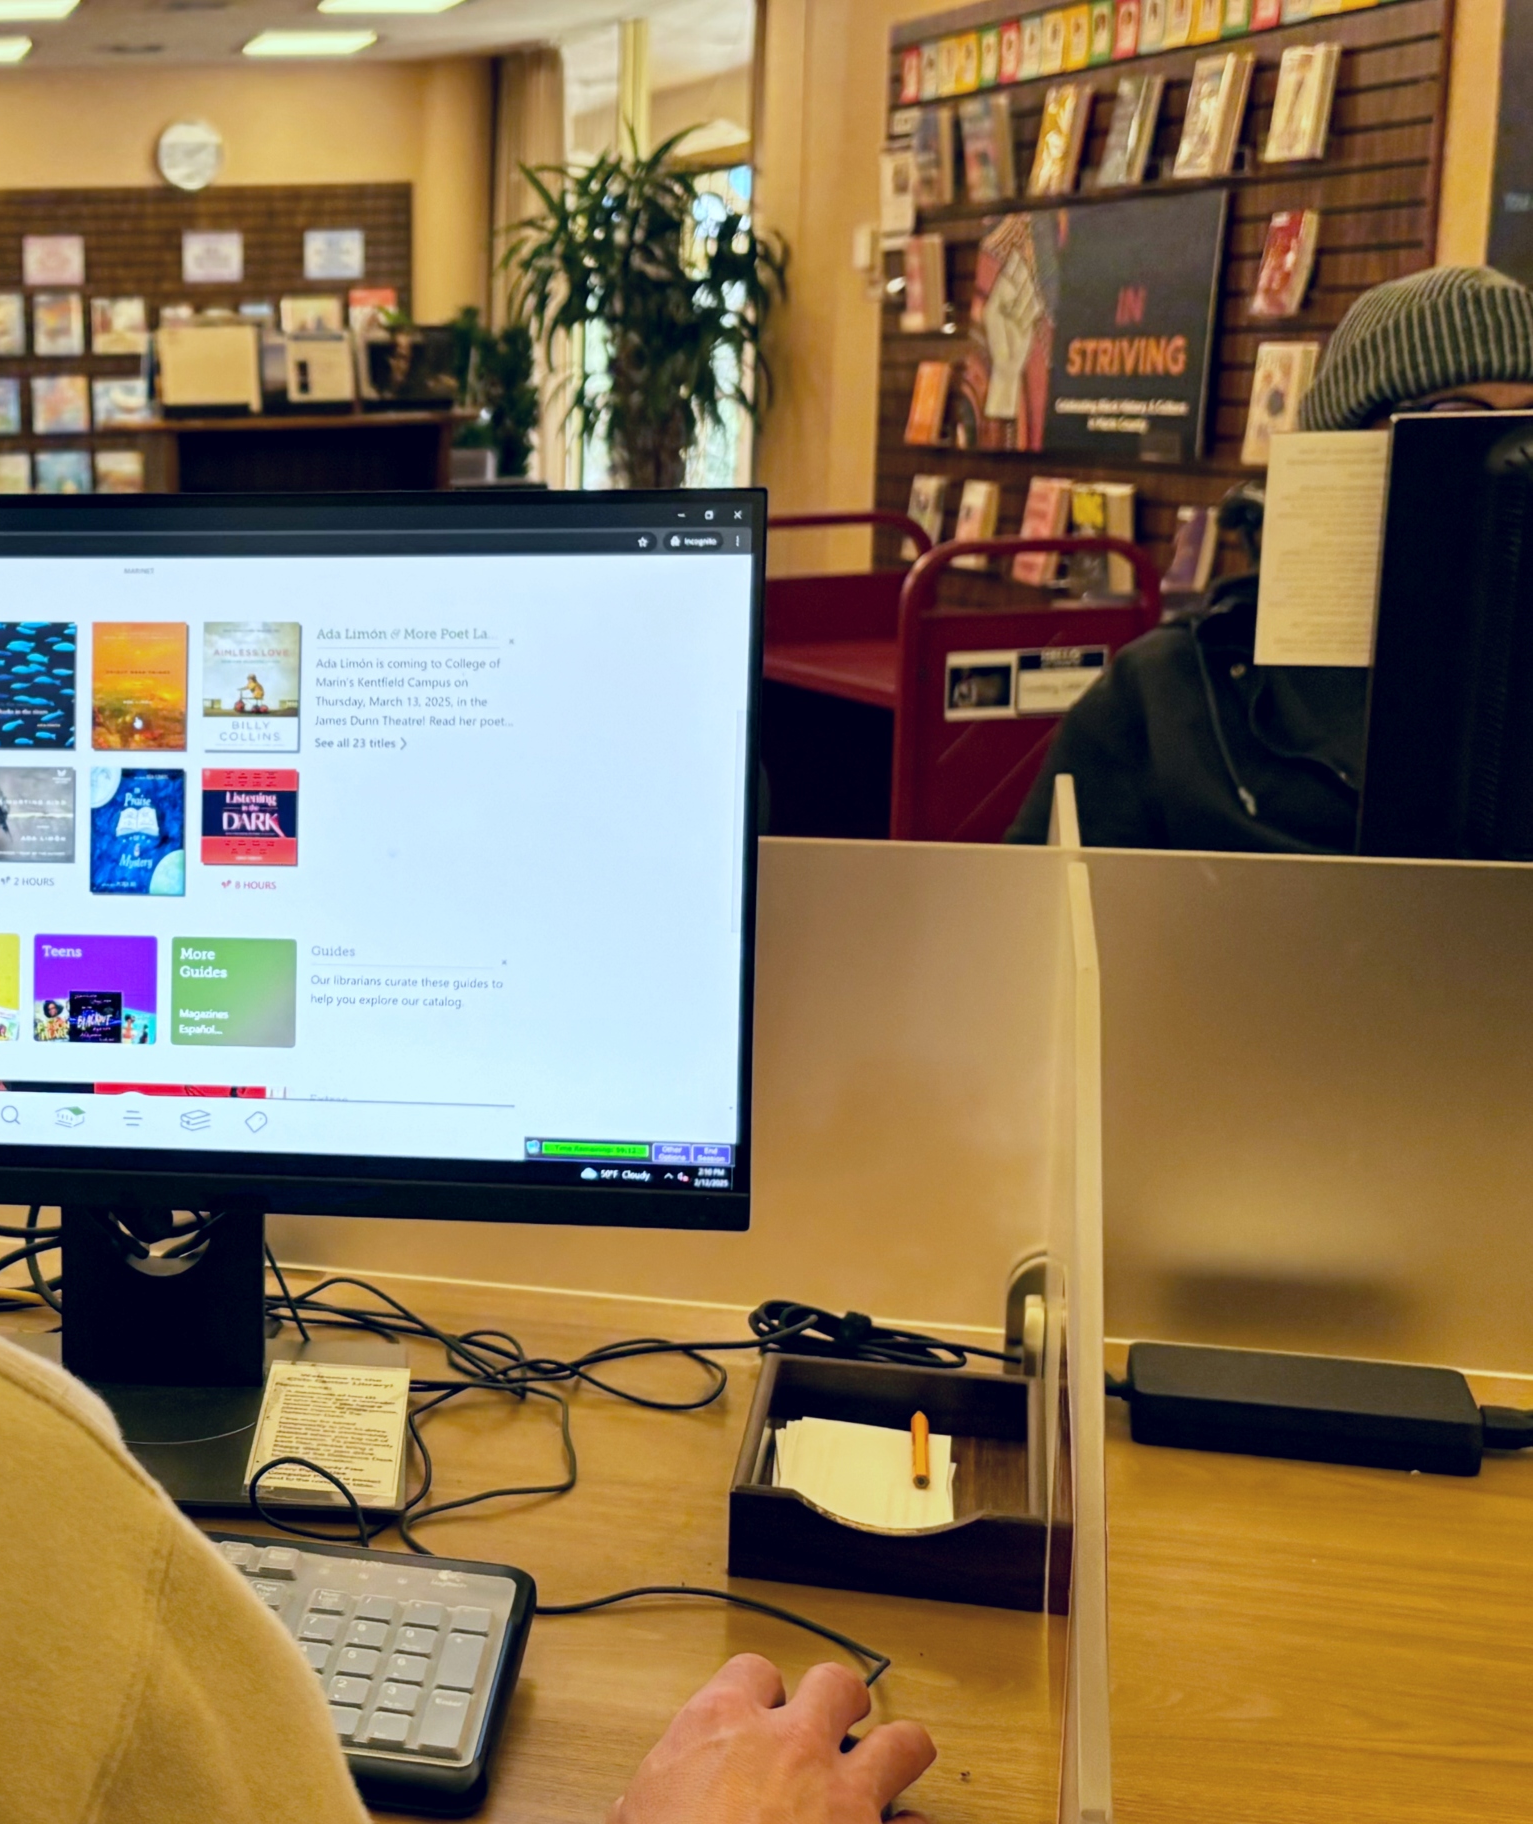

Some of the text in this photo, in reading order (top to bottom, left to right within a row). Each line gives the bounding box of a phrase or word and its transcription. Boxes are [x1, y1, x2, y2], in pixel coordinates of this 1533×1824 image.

[1115, 285, 1148, 326] IN
[1067, 335, 1188, 377] STRIVING
[316, 628, 341, 640] Ada
[344, 628, 388, 640] Limón
[403, 628, 437, 640] More
[440, 628, 470, 640] Poet
[213, 649, 290, 657] AIMLESS LOVE
[316, 658, 501, 672] Ada Limón is coming to College of
[316, 678, 354, 688] Marin's
[357, 677, 404, 688] Kentfield
[407, 678, 451, 689] Campus
[315, 697, 488, 709] Thursday, March 13, 2025, in the
[232, 721, 271, 730] BILLY
[315, 716, 347, 726] James
[350, 716, 379, 726] Dunn
[382, 715, 426, 726] Theatre!
[429, 716, 456, 726] Read
[459, 716, 477, 726] her
[219, 732, 281, 742] COLLINS
[315, 738, 396, 748] See all 23 titles
[124, 792, 152, 807] Praise
[225, 791, 277, 806] Listening
[222, 811, 285, 837] DARK
[119, 853, 153, 869] Mystery
[14, 877, 54, 886] 2 HOURS
[235, 881, 277, 889] 8 HOURS
[42, 945, 82, 957] Teens
[180, 947, 216, 960] More
[311, 946, 356, 957] Guides
[179, 965, 228, 978] Guides
[311, 975, 503, 990] Our librarians curate these guides to
[311, 994, 464, 1009] help you explore our catalog.
[179, 1008, 229, 1020] Magazines
[622, 1170, 651, 1181] Cloudy
[309, 1617, 318, 1625] 7
[337, 1679, 348, 1688] 2
